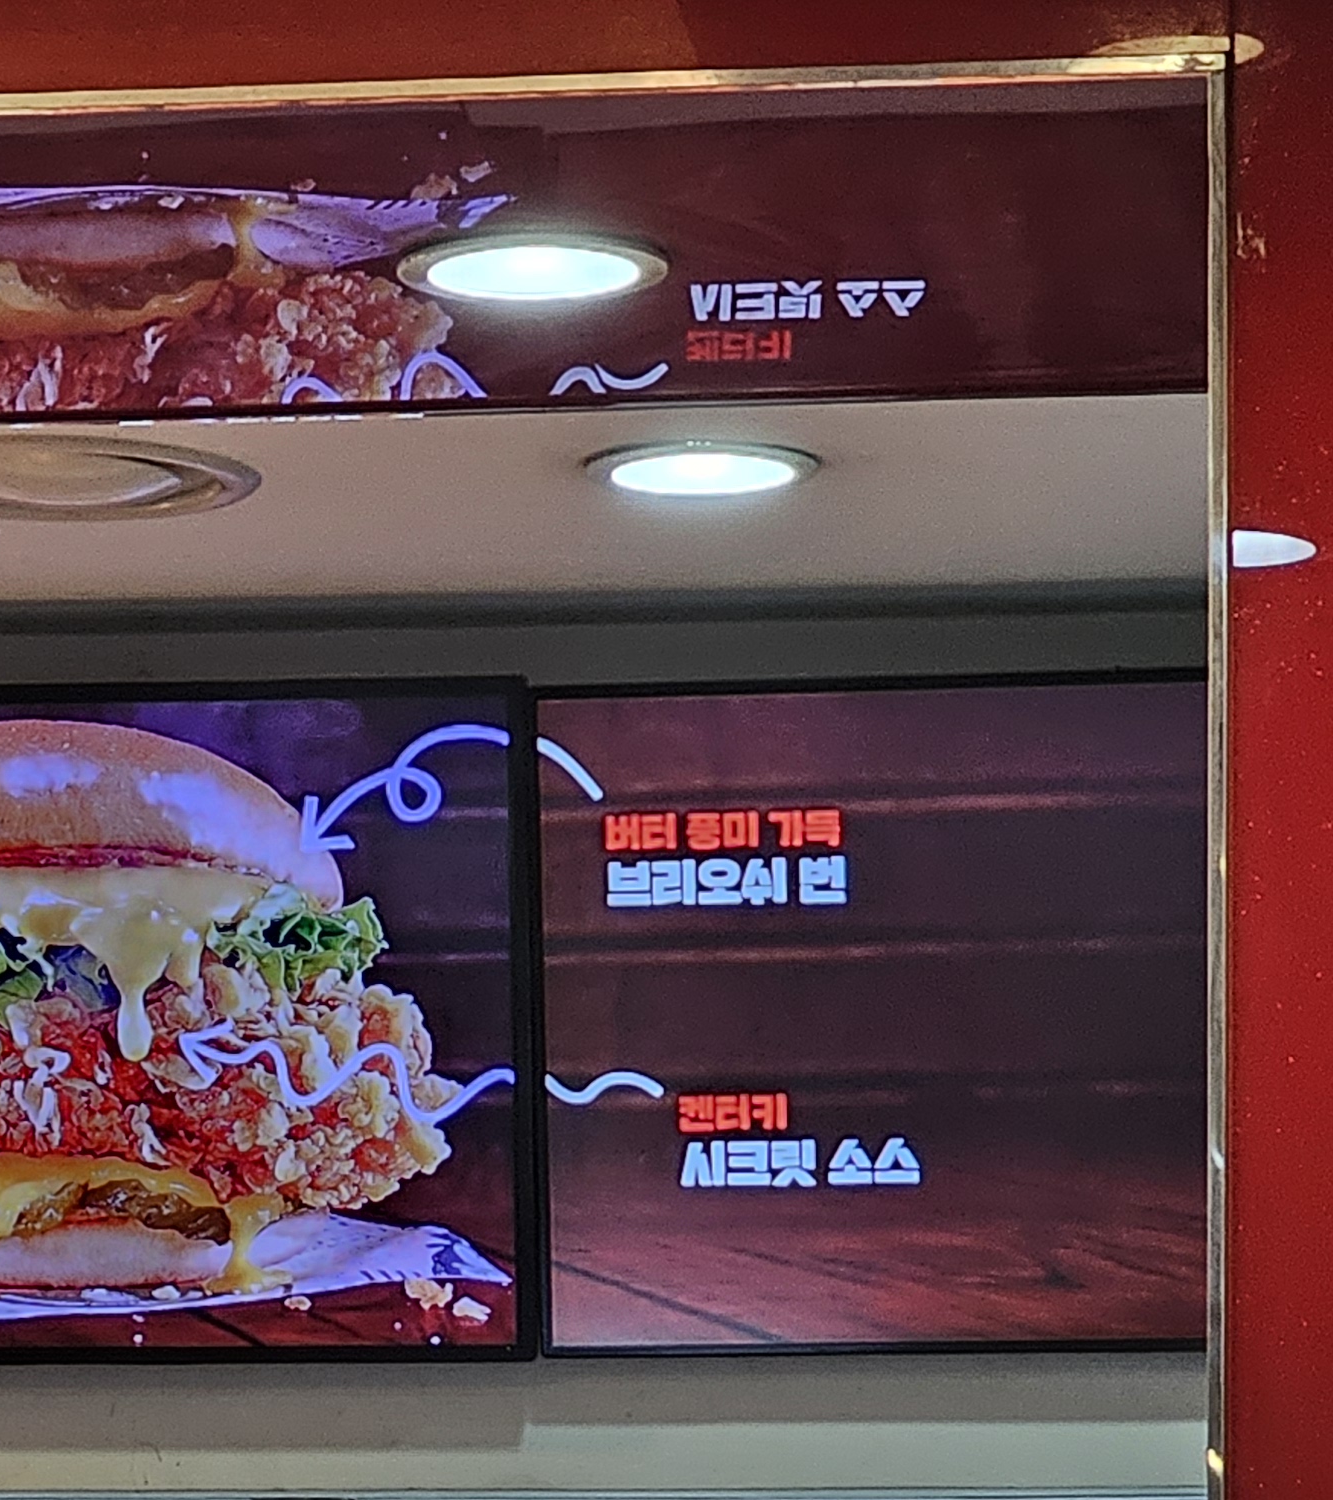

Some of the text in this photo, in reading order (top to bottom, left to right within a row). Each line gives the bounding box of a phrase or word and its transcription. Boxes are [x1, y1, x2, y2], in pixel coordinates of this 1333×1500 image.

[604, 808, 841, 851] 버터 풍미 가득
[606, 854, 847, 907] 브리오쉬 번
[677, 1092, 788, 1133] 켄터키
[680, 1136, 921, 1187] 시크릿 소스
